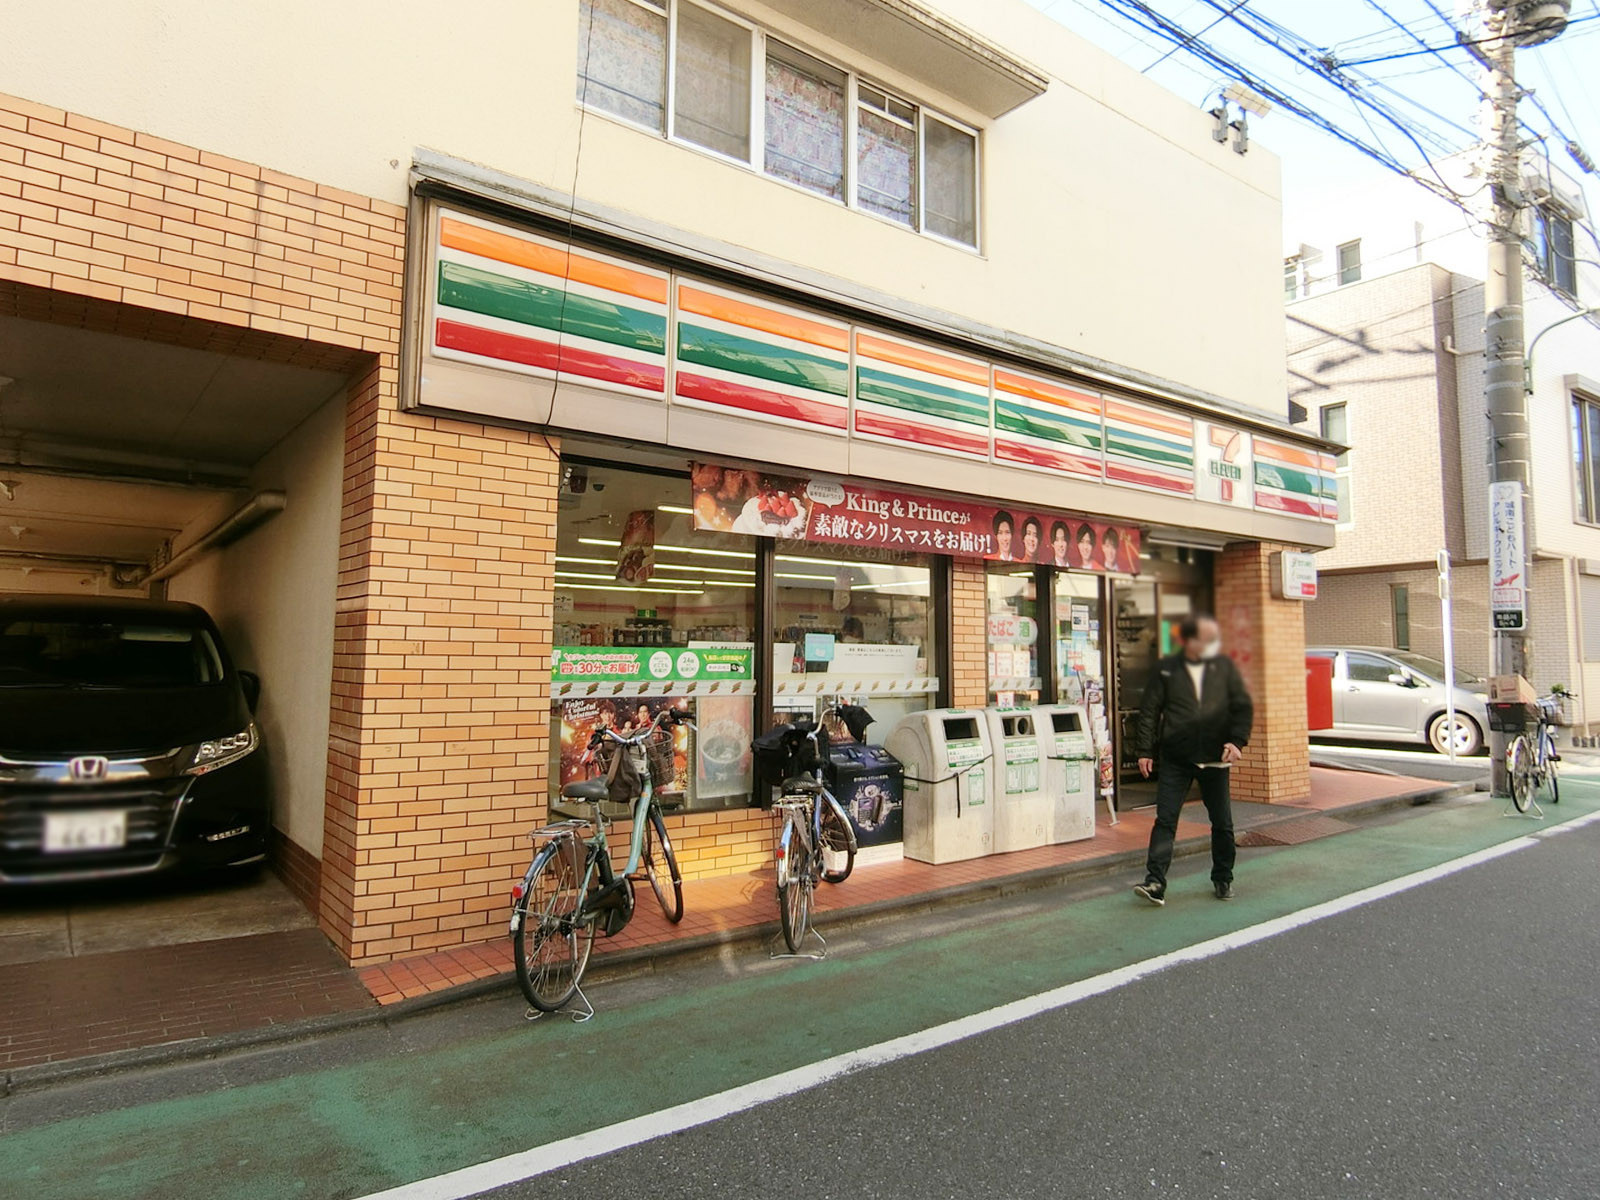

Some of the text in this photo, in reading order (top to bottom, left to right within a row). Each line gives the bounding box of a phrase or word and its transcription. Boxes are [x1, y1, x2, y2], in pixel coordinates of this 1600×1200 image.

[846, 492, 890, 520] King
[892, 499, 905, 517] &
[988, 620, 1014, 636] たばこ
